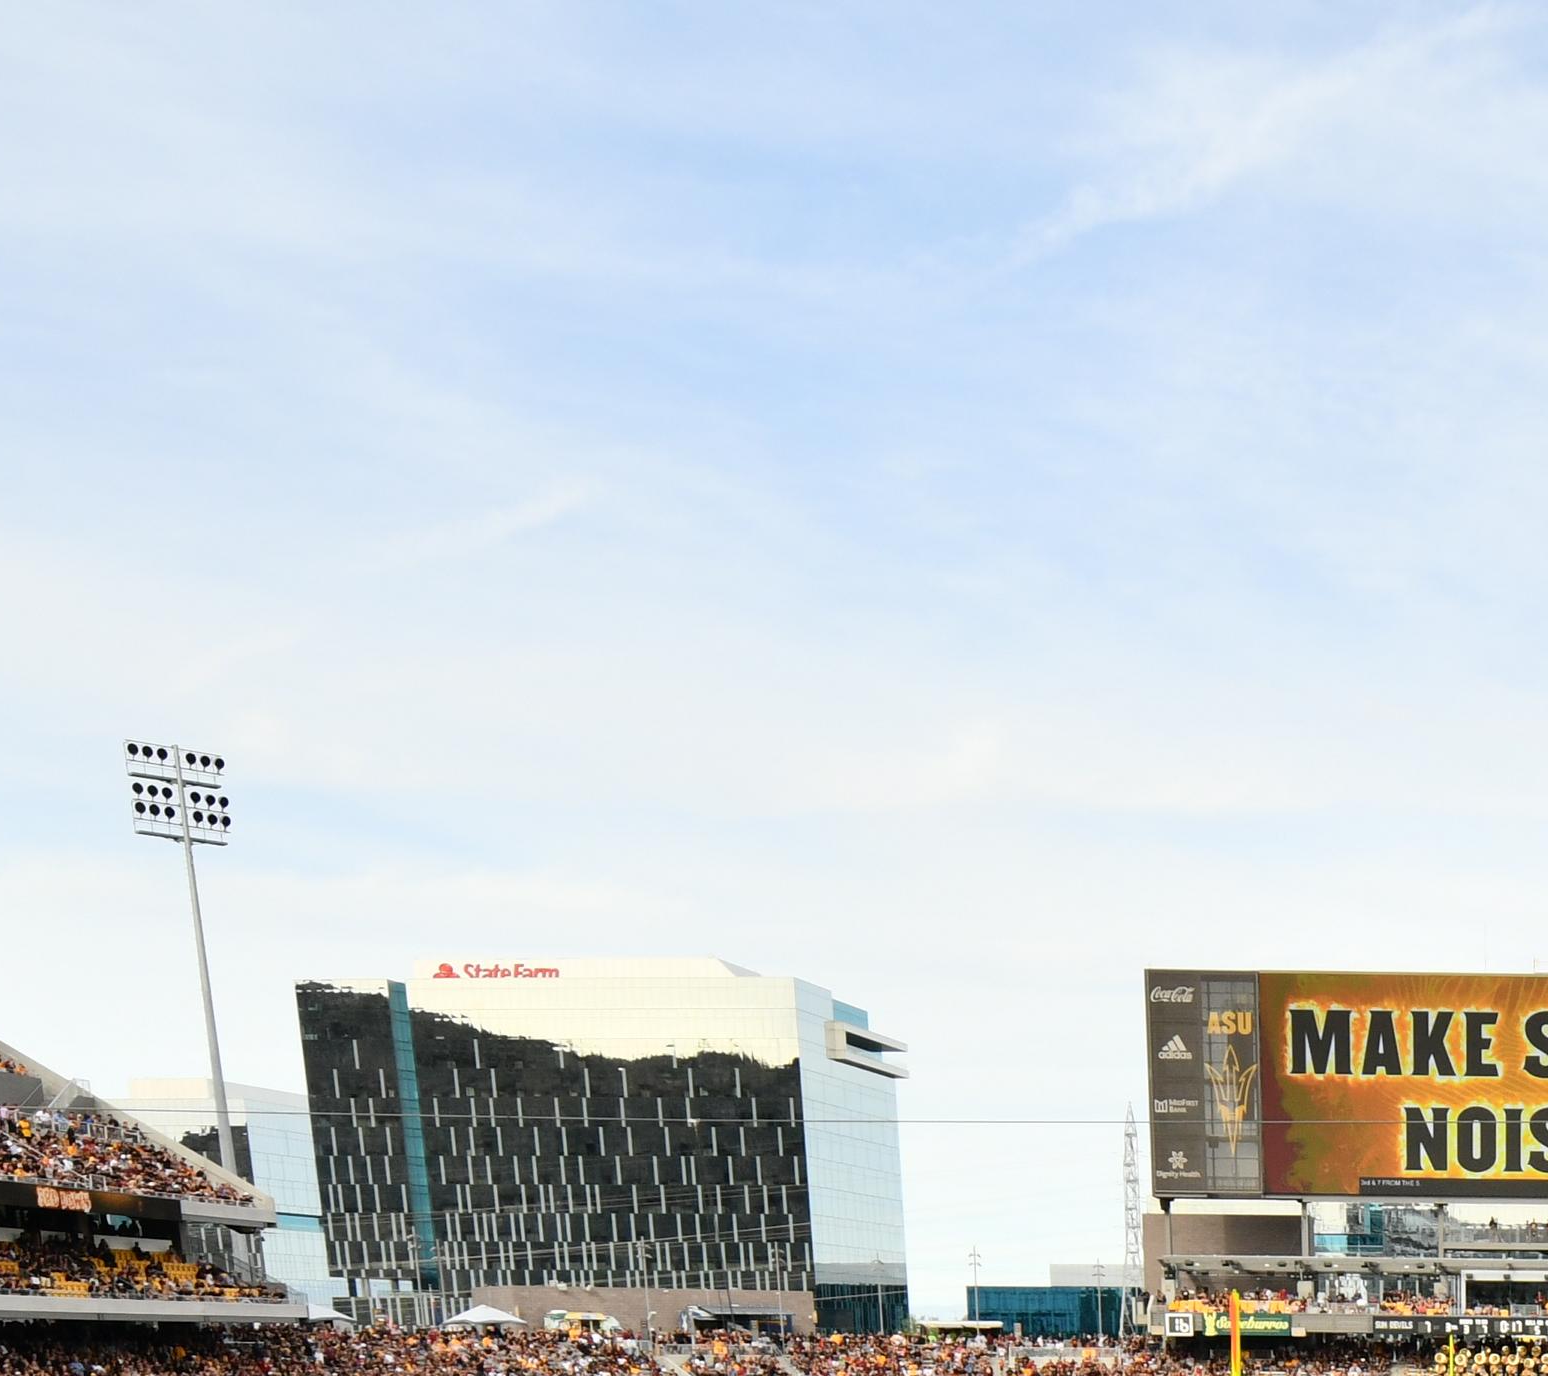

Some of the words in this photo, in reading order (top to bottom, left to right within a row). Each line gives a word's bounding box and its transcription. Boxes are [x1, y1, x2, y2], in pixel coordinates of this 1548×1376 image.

[463, 963, 511, 977] State
[514, 964, 559, 977] Farm
[1207, 1011, 1252, 1035] ASU
[1289, 1009, 1499, 1077] MAKE
[1158, 1051, 1192, 1060] adidas
[1499, 1320, 1523, 1333] 0:17
